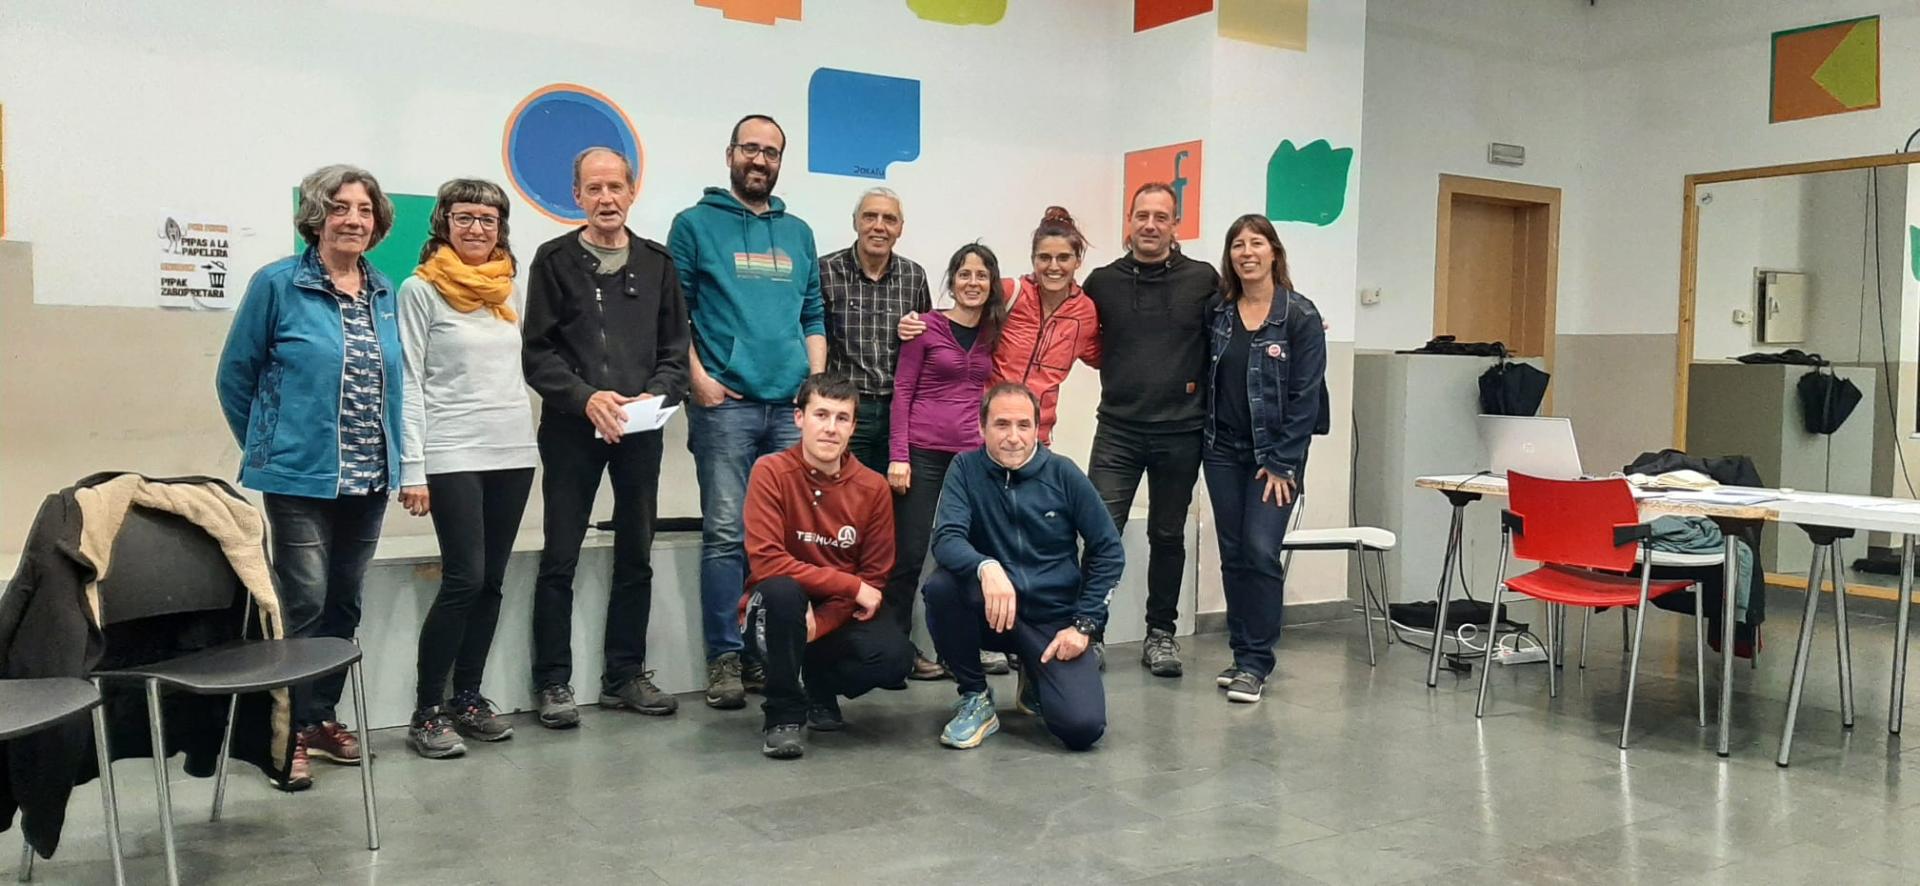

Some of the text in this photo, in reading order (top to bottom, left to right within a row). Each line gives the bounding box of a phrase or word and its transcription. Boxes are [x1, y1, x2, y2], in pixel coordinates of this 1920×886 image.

[181, 238, 228, 248] PIPAS A LA
[182, 248, 228, 257] PAPELERA
